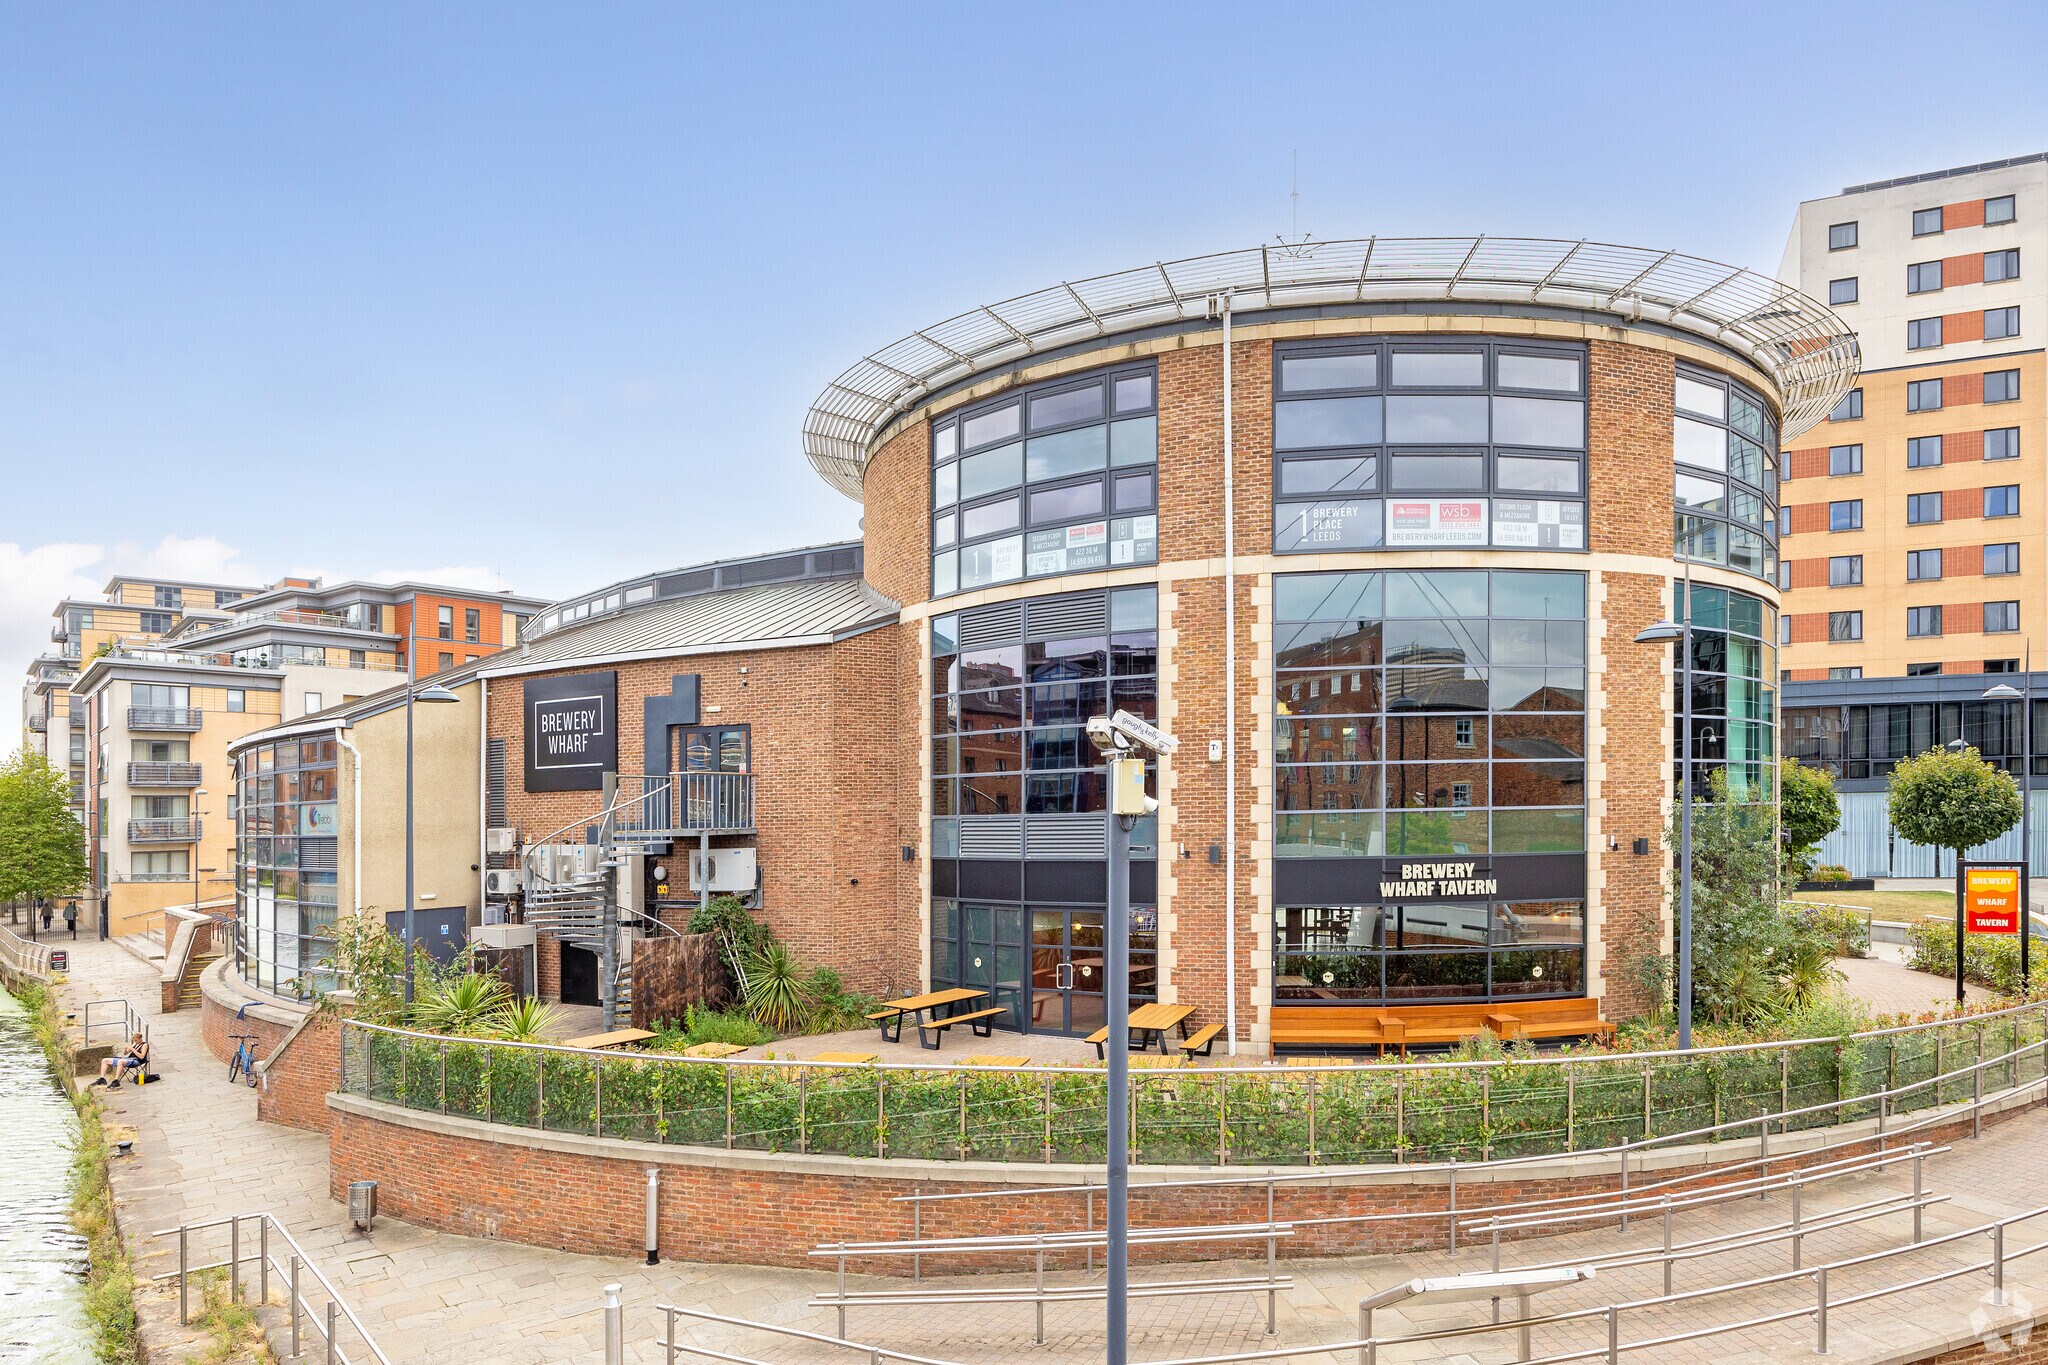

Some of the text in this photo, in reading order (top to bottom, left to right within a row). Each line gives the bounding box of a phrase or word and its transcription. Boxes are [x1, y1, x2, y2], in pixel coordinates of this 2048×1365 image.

[1313, 507, 1358, 518] BREWERY
[1440, 504, 1470, 517] wsb
[1300, 509, 1308, 542] 1
[1313, 519, 1342, 530] PLACE
[1032, 534, 1048, 542] SECOND
[1313, 531, 1341, 542] LEEDS
[1392, 532, 1482, 541] BREWERYWHARFLEEDS.COM
[542, 710, 595, 733] BREWERY
[548, 733, 588, 754] WHARF
[1402, 863, 1475, 879] BREWERY
[1380, 879, 1497, 897] WHARF TAVERN
[1976, 918, 2008, 926] TAVERN
